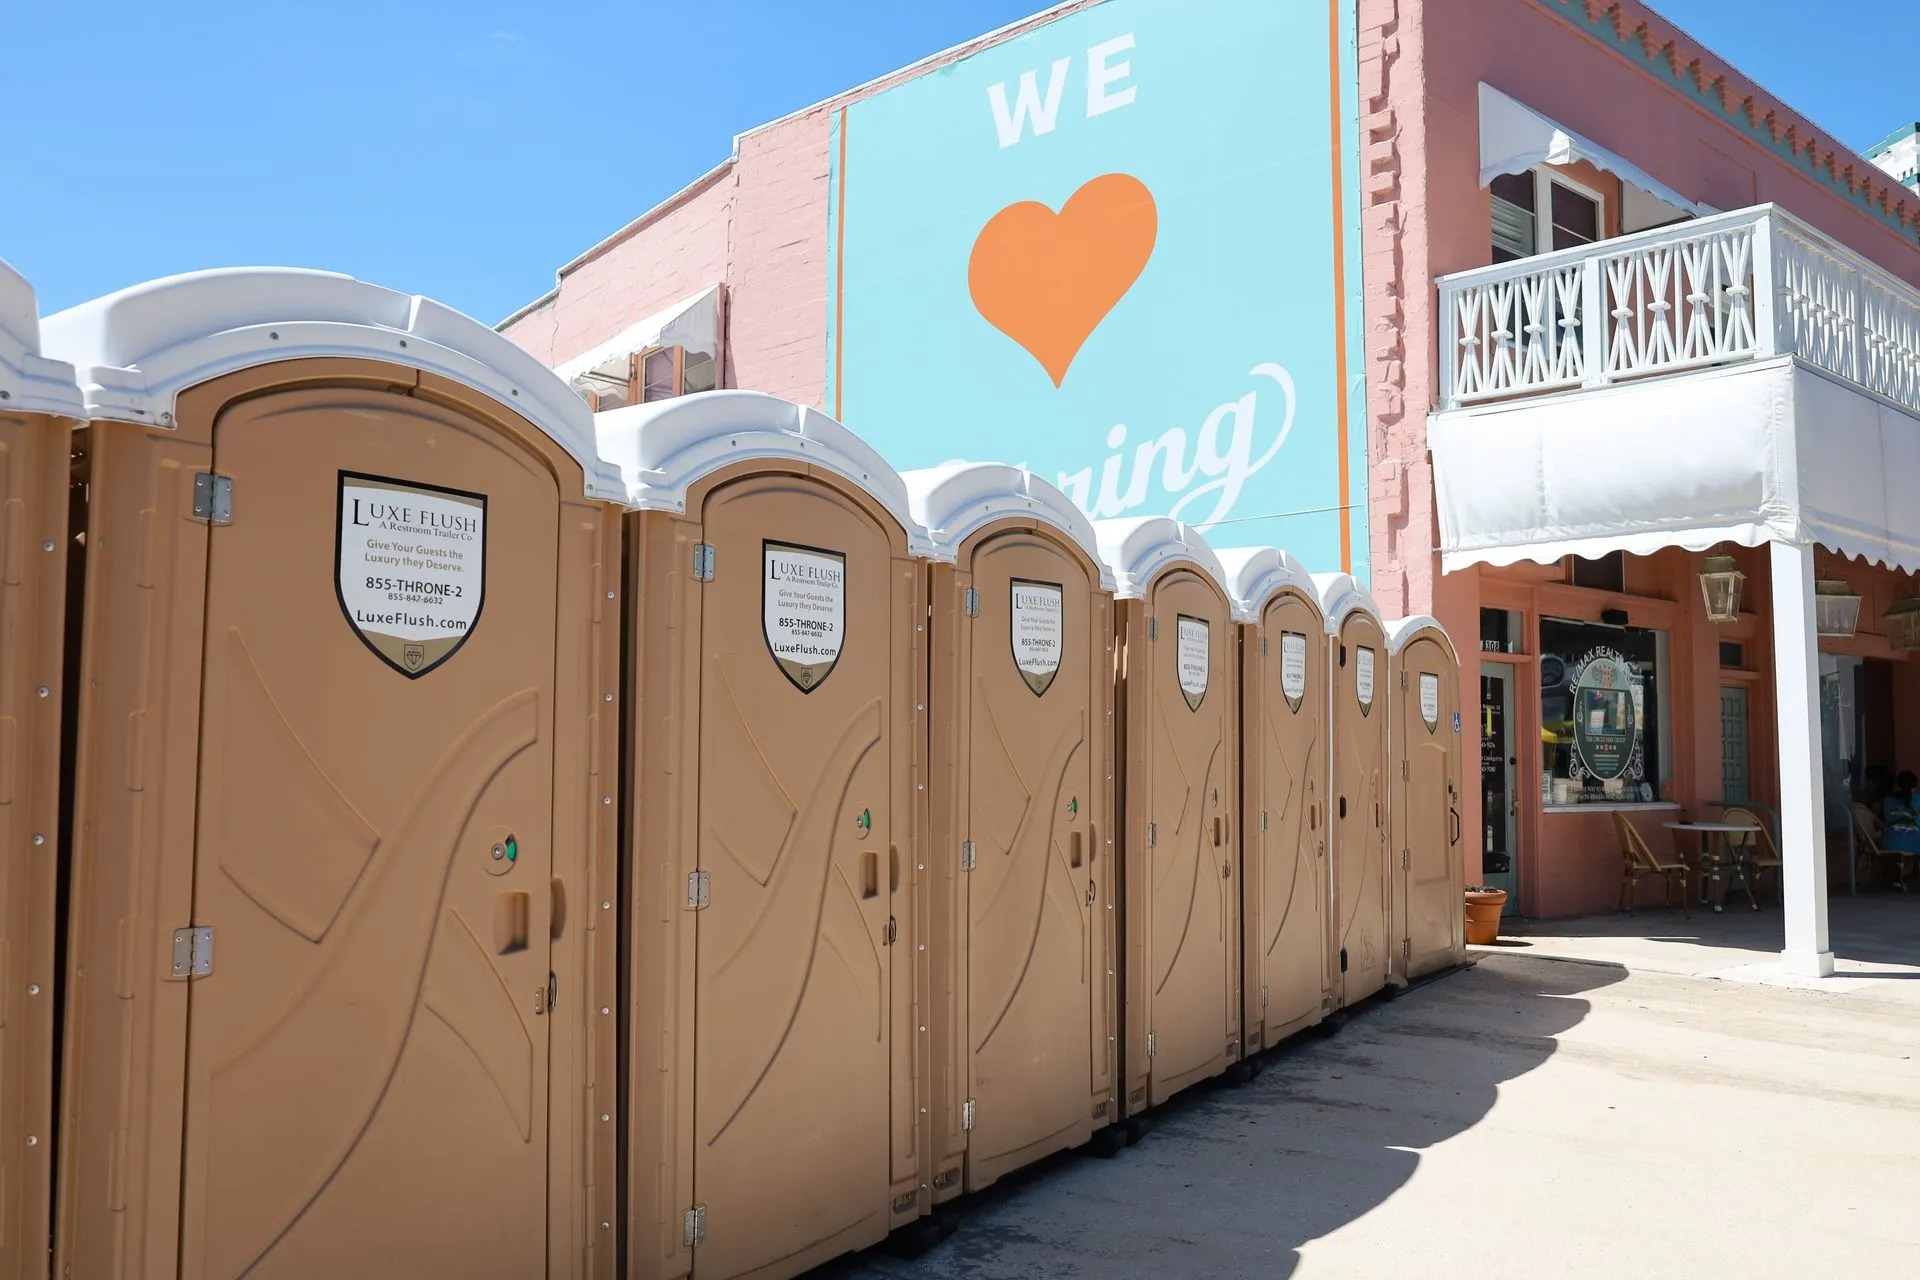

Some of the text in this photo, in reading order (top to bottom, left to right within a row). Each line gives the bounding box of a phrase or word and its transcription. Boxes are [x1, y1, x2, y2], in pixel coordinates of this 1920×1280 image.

[986, 32, 1138, 149] WE
[939, 362, 1296, 533] ring
[352, 498, 476, 532] LUXE FLUSH
[379, 521, 474, 541] A Restroom Trailer Co.
[366, 539, 463, 560] Give Your Guests the
[365, 552, 464, 573] Luxury they Deserve.
[770, 560, 840, 582] LUXE FLUSH
[366, 577, 462, 597] 855-THRONE-2
[779, 589, 792, 597] Give
[793, 590, 806, 599] Your
[807, 592, 824, 602] Guests
[388, 592, 443, 604] 855-847-6632
[778, 600, 798, 609] Luxury
[799, 602, 811, 611] they
[1016, 593, 1059, 609] LUXE FLUSH
[357, 610, 467, 630] LuxeFlush.com
[779, 617, 834, 631] 855-THRONE-2
[774, 642, 836, 656] LuxeFlush.com
[1019, 657, 1057, 667] LuxeFlush.com
[1569, 648, 1596, 694] RE/MAX
